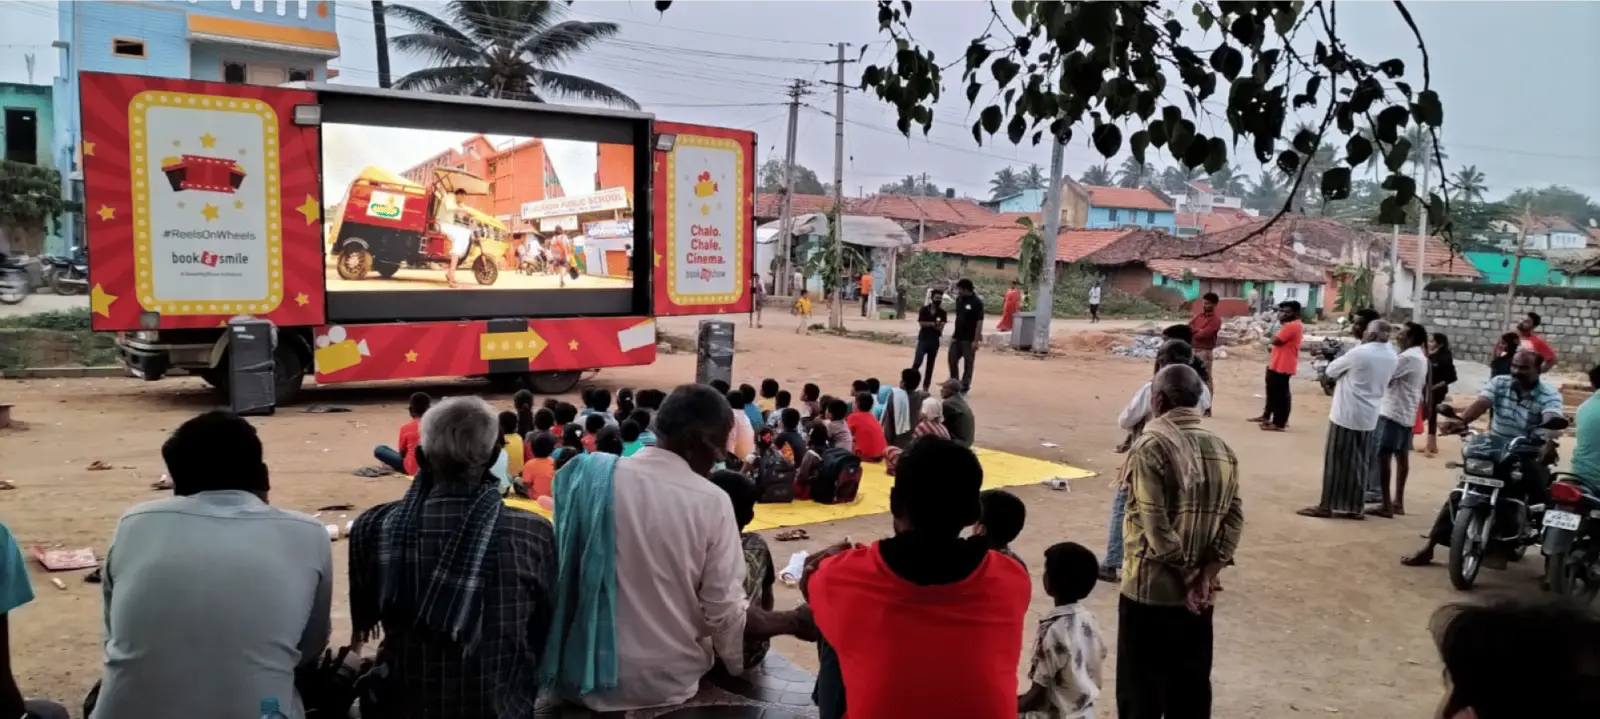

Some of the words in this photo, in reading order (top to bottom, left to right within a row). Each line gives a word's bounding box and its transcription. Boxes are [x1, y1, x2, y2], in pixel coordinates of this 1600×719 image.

[163, 229, 257, 241] #ReelsOnWheels
[690, 223, 721, 237] Chalo.
[690, 238, 721, 251] Chale.
[686, 252, 726, 264] Cinema.
